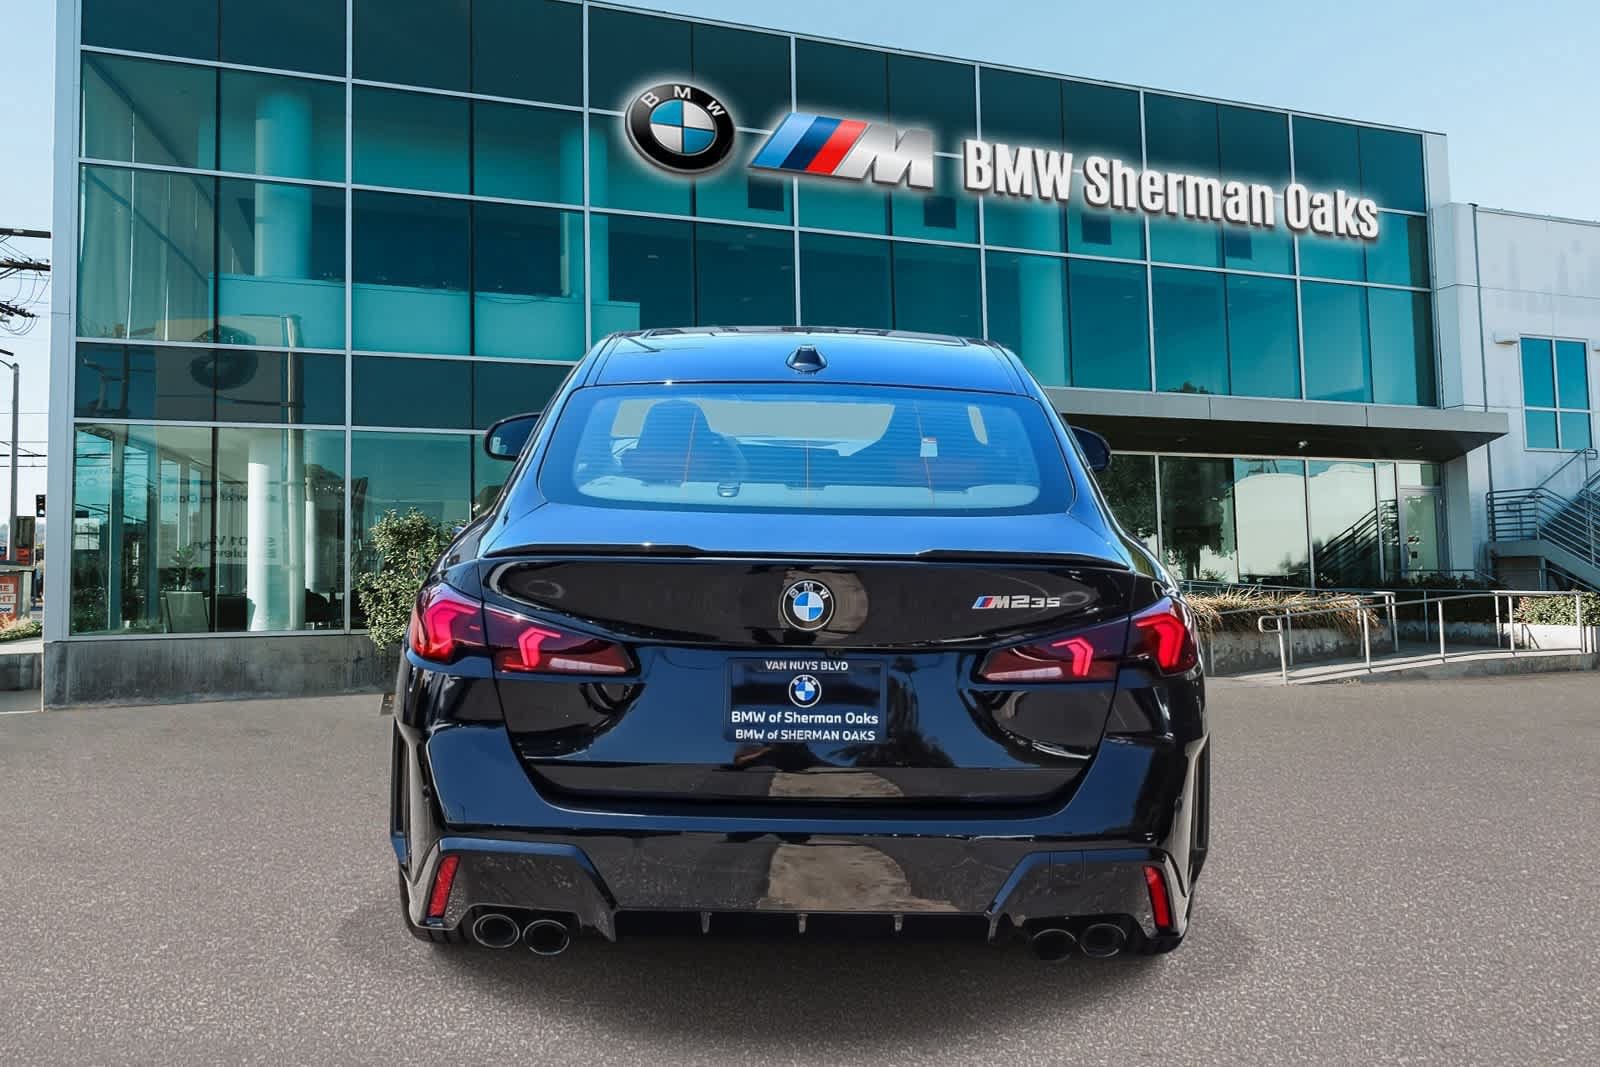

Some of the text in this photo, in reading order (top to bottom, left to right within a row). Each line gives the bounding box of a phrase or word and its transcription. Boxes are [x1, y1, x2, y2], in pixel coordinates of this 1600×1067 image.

[640, 84, 726, 118] BMW
[963, 138, 1380, 241] BMW Sherman Oaks
[789, 582, 830, 600] BMW
[991, 594, 1061, 609] M235
[765, 660, 849, 671] VAN NUYS BLVD
[731, 711, 879, 725] BMW of Sherman Oaks
[735, 729, 876, 741] BMW of SHERMAN OAKS
